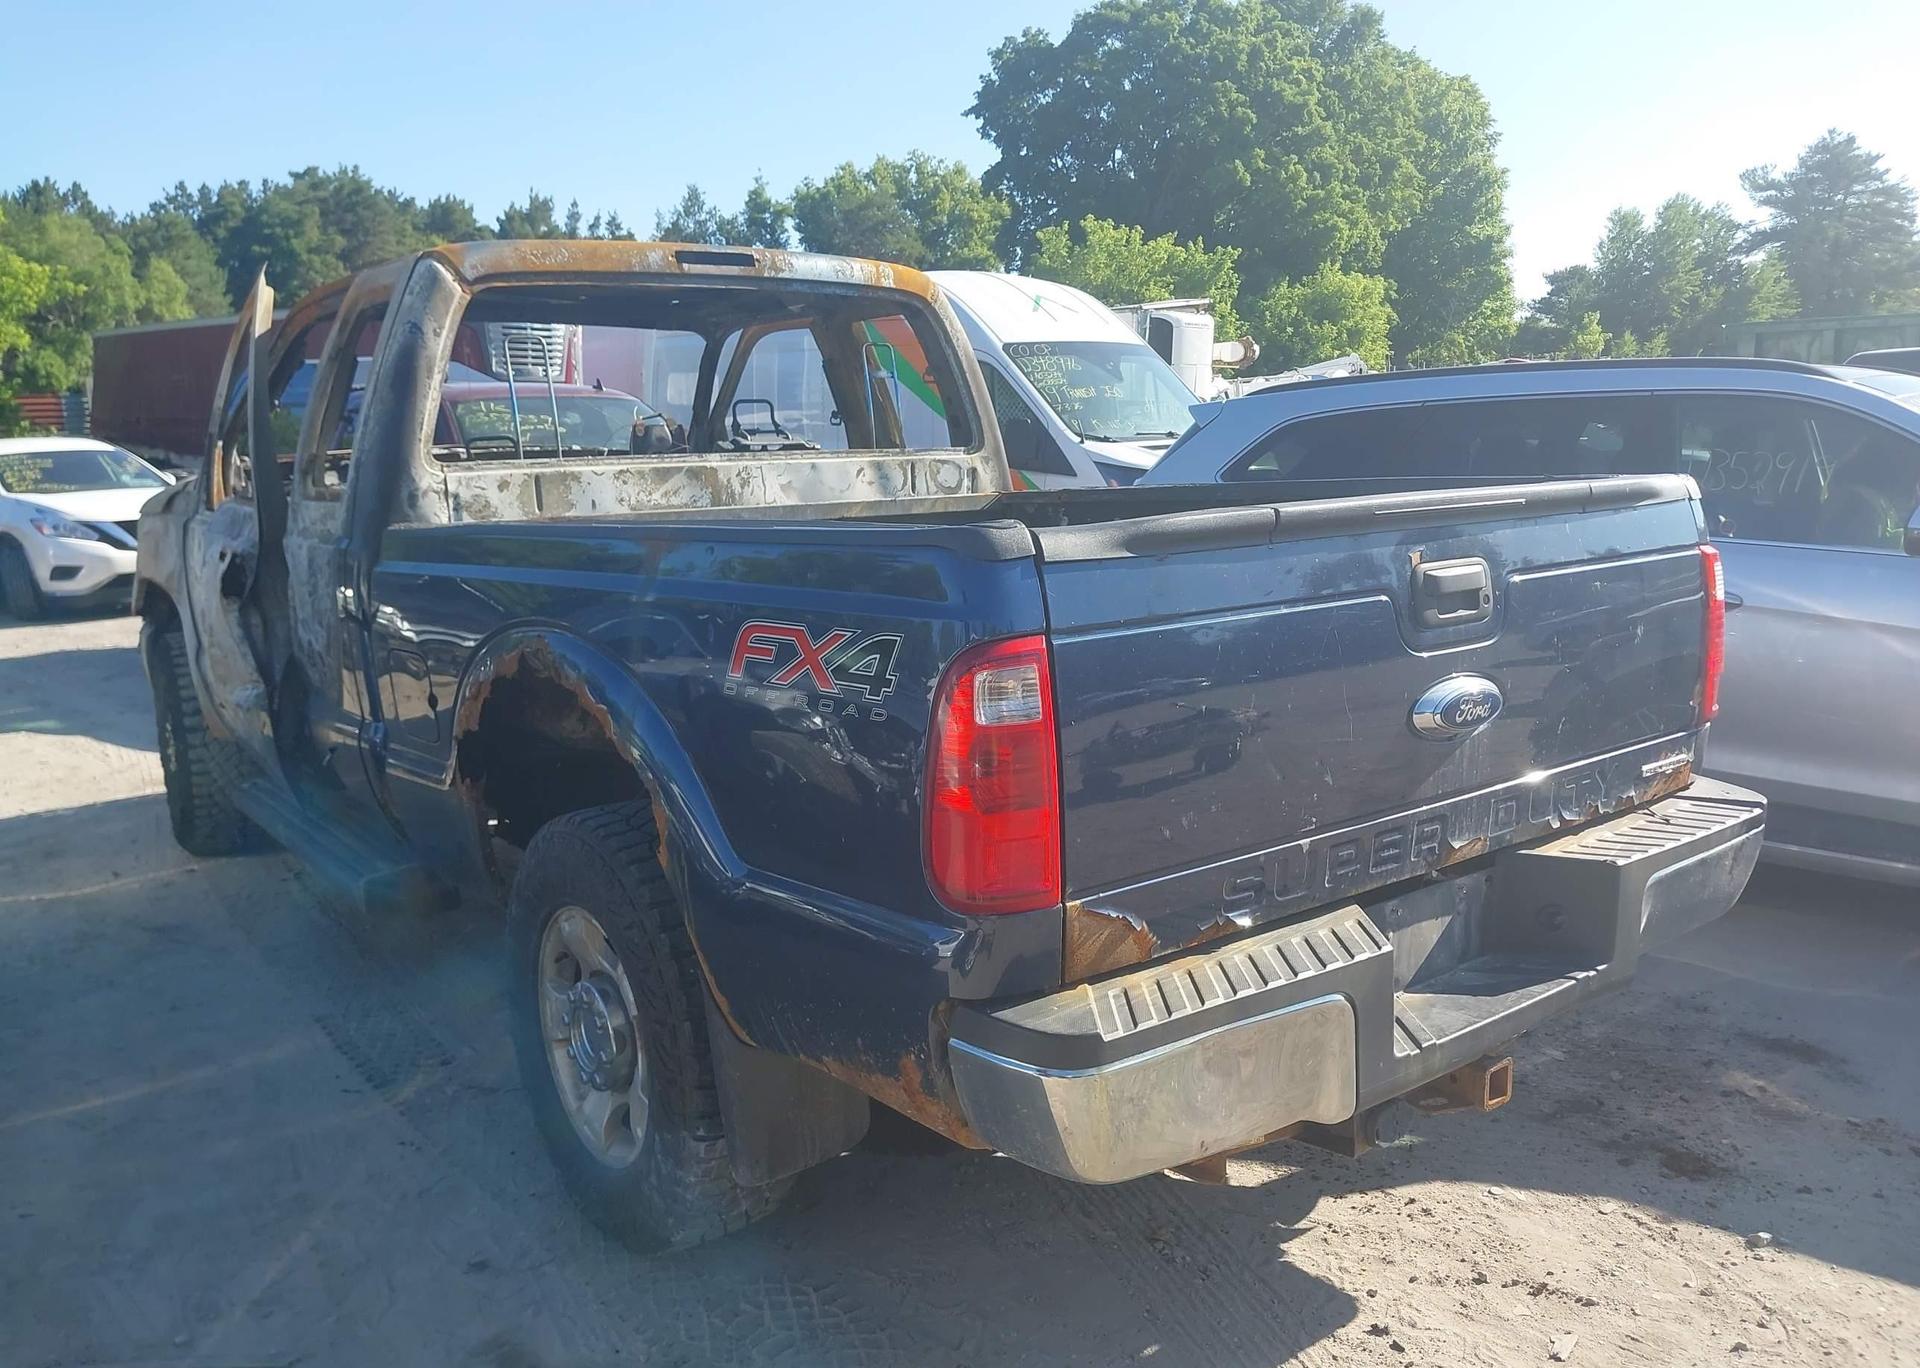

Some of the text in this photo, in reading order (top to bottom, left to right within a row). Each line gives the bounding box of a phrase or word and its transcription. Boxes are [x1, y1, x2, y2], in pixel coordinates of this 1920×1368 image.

[726, 618, 904, 703] FX4
[723, 682, 888, 722] OFF ROAD
[1455, 694, 1492, 724] Ford
[1221, 758, 1620, 917] SUPER DUTY
